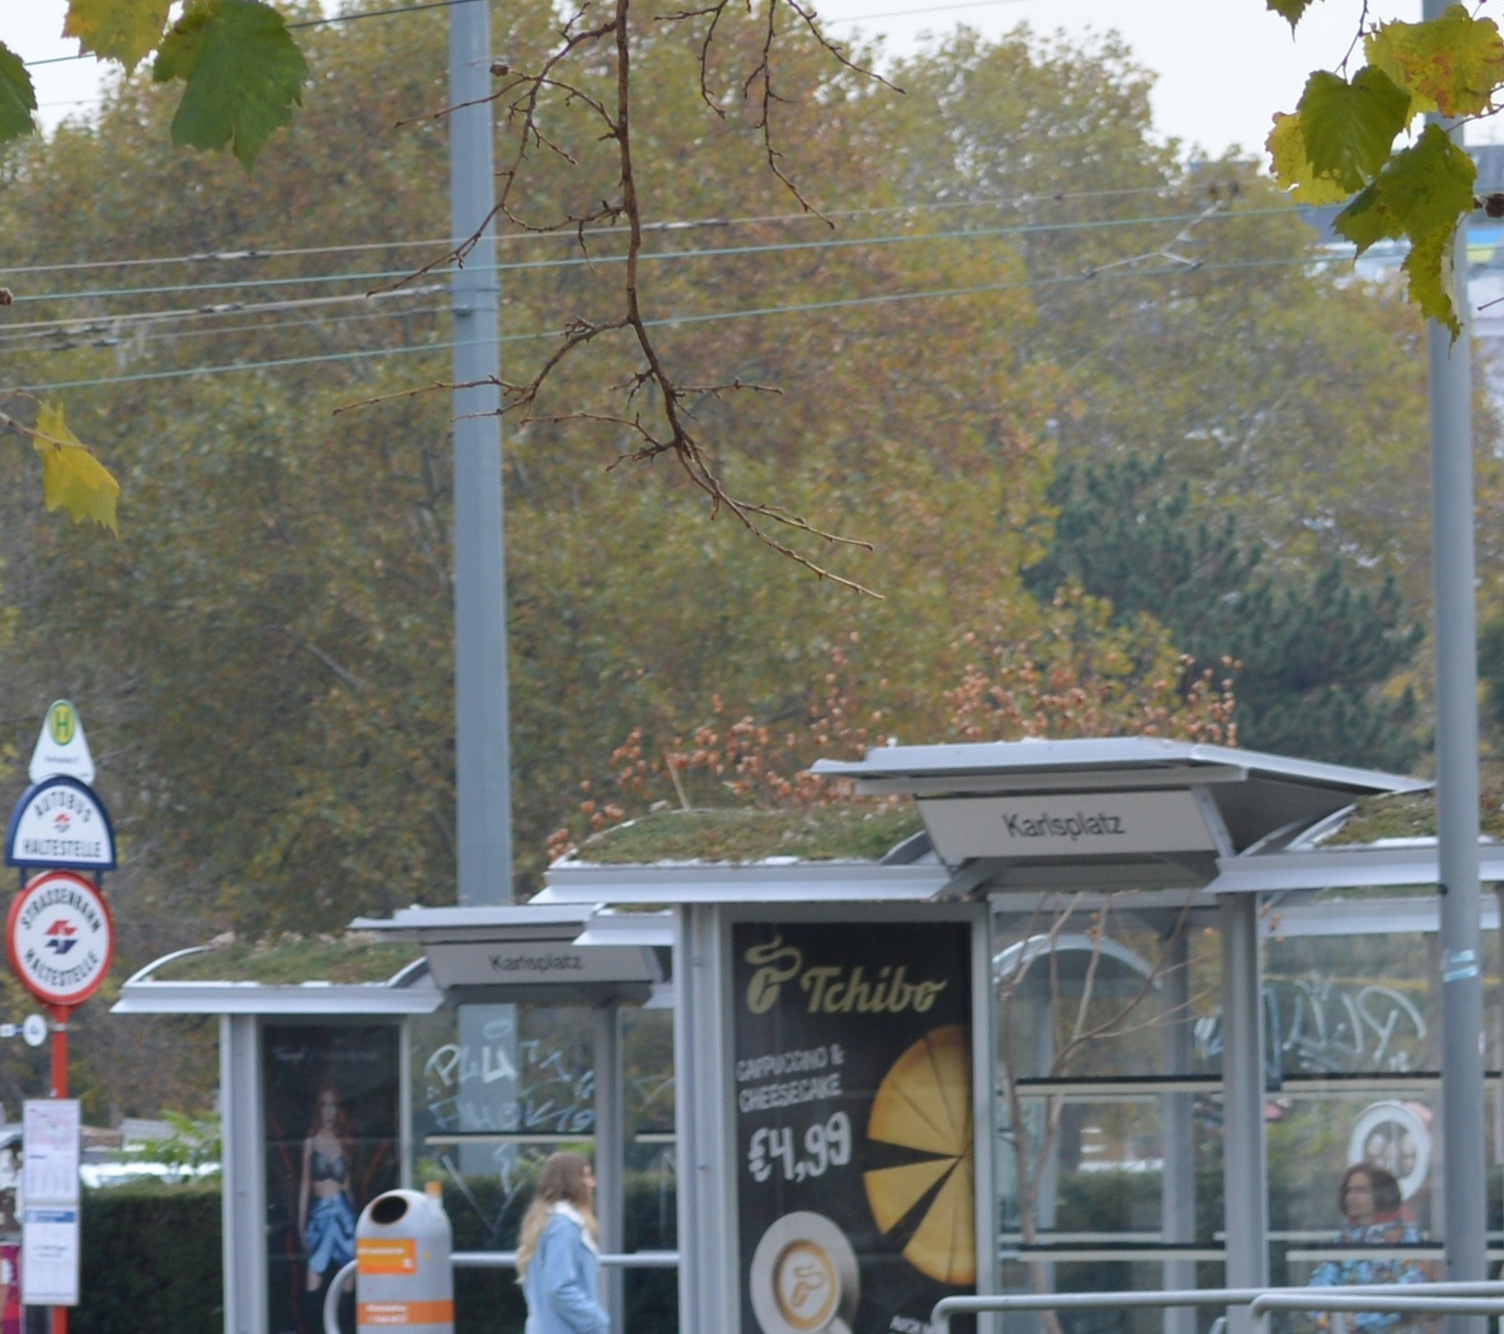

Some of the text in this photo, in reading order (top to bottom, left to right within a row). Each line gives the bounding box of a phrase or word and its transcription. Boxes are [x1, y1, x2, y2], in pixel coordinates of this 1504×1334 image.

[34, 791, 92, 823] AUTOBUS
[1002, 812, 1125, 842] Karlsplatz
[23, 838, 101, 858] HALTESTELLE
[21, 888, 102, 930] STRASSENBAHN
[24, 948, 98, 987] HALTESTELLE
[490, 954, 583, 973] Karlsplatz
[800, 967, 947, 1013] Tchibo
[736, 1044, 845, 1082] CAPPUCCINO &
[738, 1073, 841, 1113] CHEESECAKE
[748, 1111, 853, 1183] €4,99
